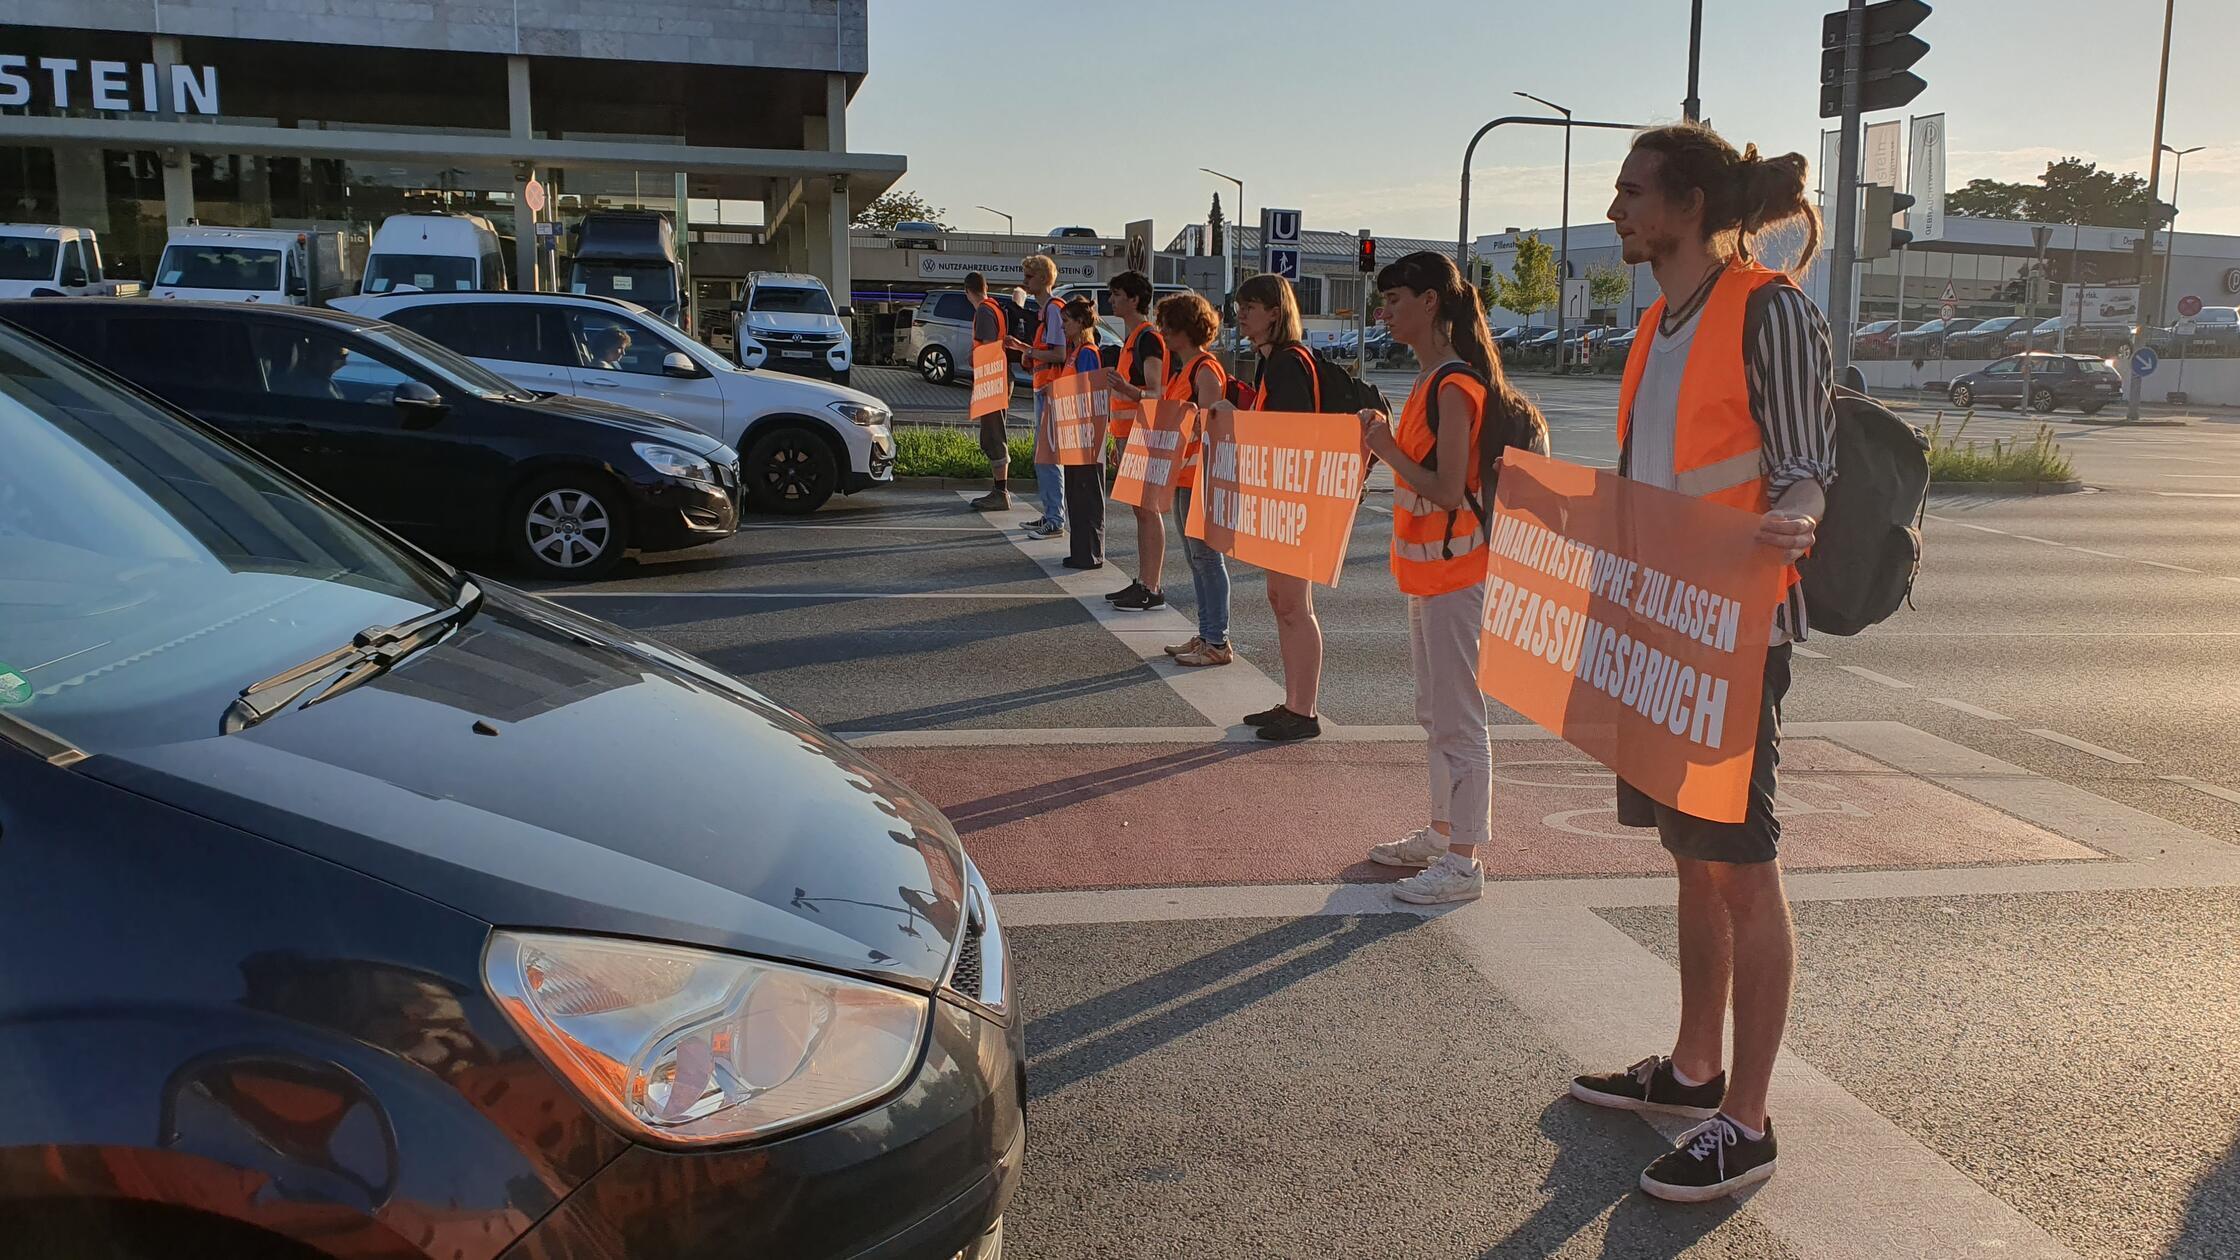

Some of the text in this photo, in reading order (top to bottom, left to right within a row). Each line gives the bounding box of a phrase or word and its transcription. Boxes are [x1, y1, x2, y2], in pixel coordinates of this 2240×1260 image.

[0, 54, 218, 115] STEIN
[1275, 213, 1296, 239] U
[938, 263, 999, 272] NUTZFAHRZEUG
[1000, 264, 1023, 273] ZENTR
[1058, 266, 1081, 275] STEIN
[1239, 443, 1268, 487] HEILE
[1272, 447, 1314, 493] WELT
[1316, 451, 1361, 499] HIER
[1226, 490, 1257, 536] LANGE
[1260, 497, 1307, 546] NOCH?
[1634, 569, 1741, 653] ZULASSEN
